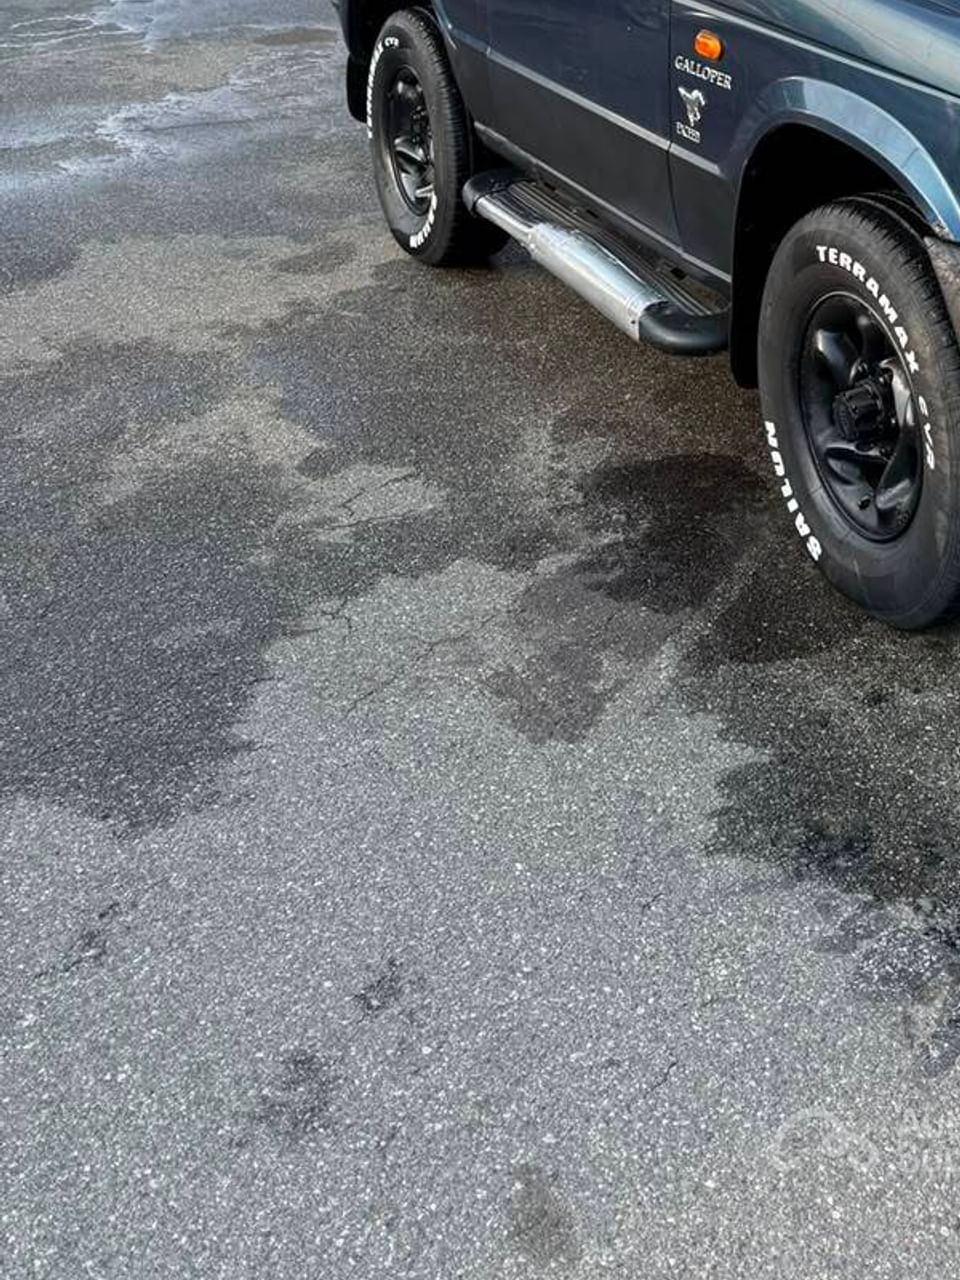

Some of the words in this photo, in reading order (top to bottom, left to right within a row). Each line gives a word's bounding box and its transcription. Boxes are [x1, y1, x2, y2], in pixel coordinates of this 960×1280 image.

[675, 55, 732, 90] GALLOPER
[816, 245, 920, 374] TERRAMAX
[764, 421, 823, 561] SAILUN
